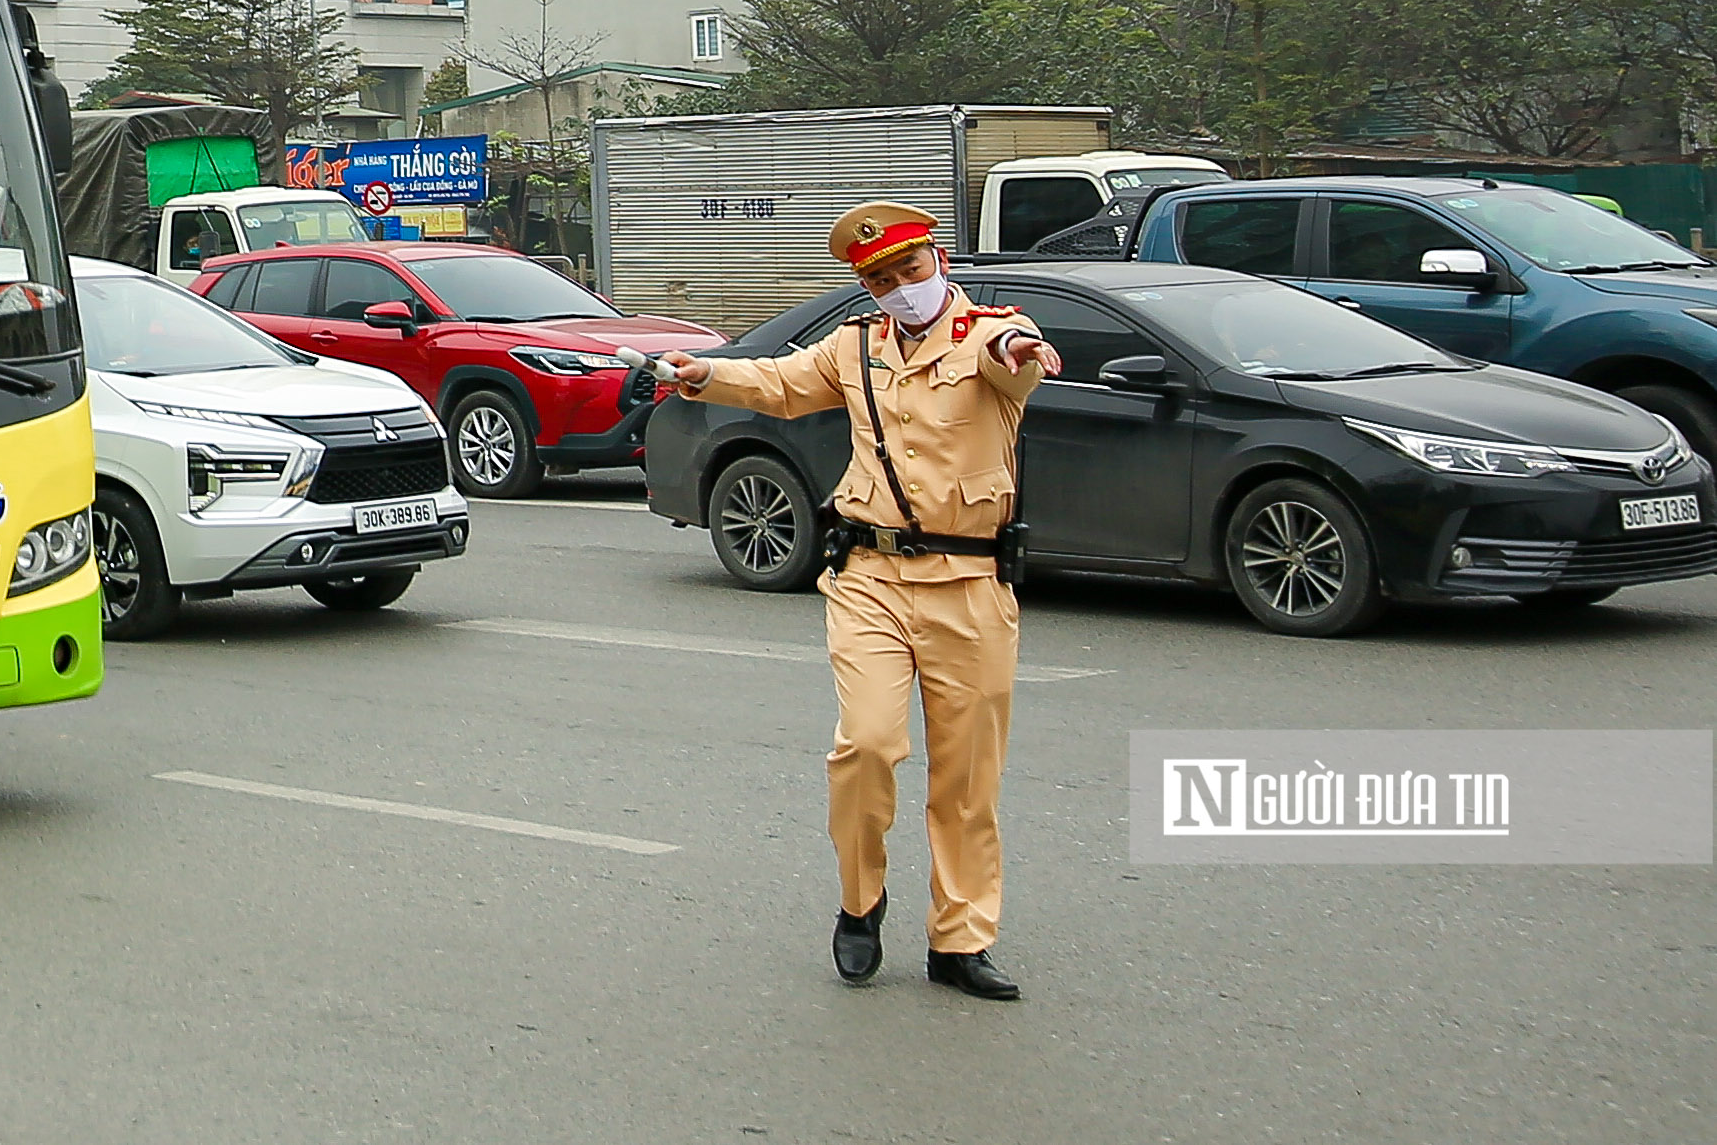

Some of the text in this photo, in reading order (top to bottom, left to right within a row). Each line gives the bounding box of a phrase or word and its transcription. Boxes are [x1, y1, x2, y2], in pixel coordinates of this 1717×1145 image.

[390, 144, 445, 177] THẮNG
[362, 504, 431, 528] 30K-389.86
[1623, 497, 1698, 526] 30F-513.86
